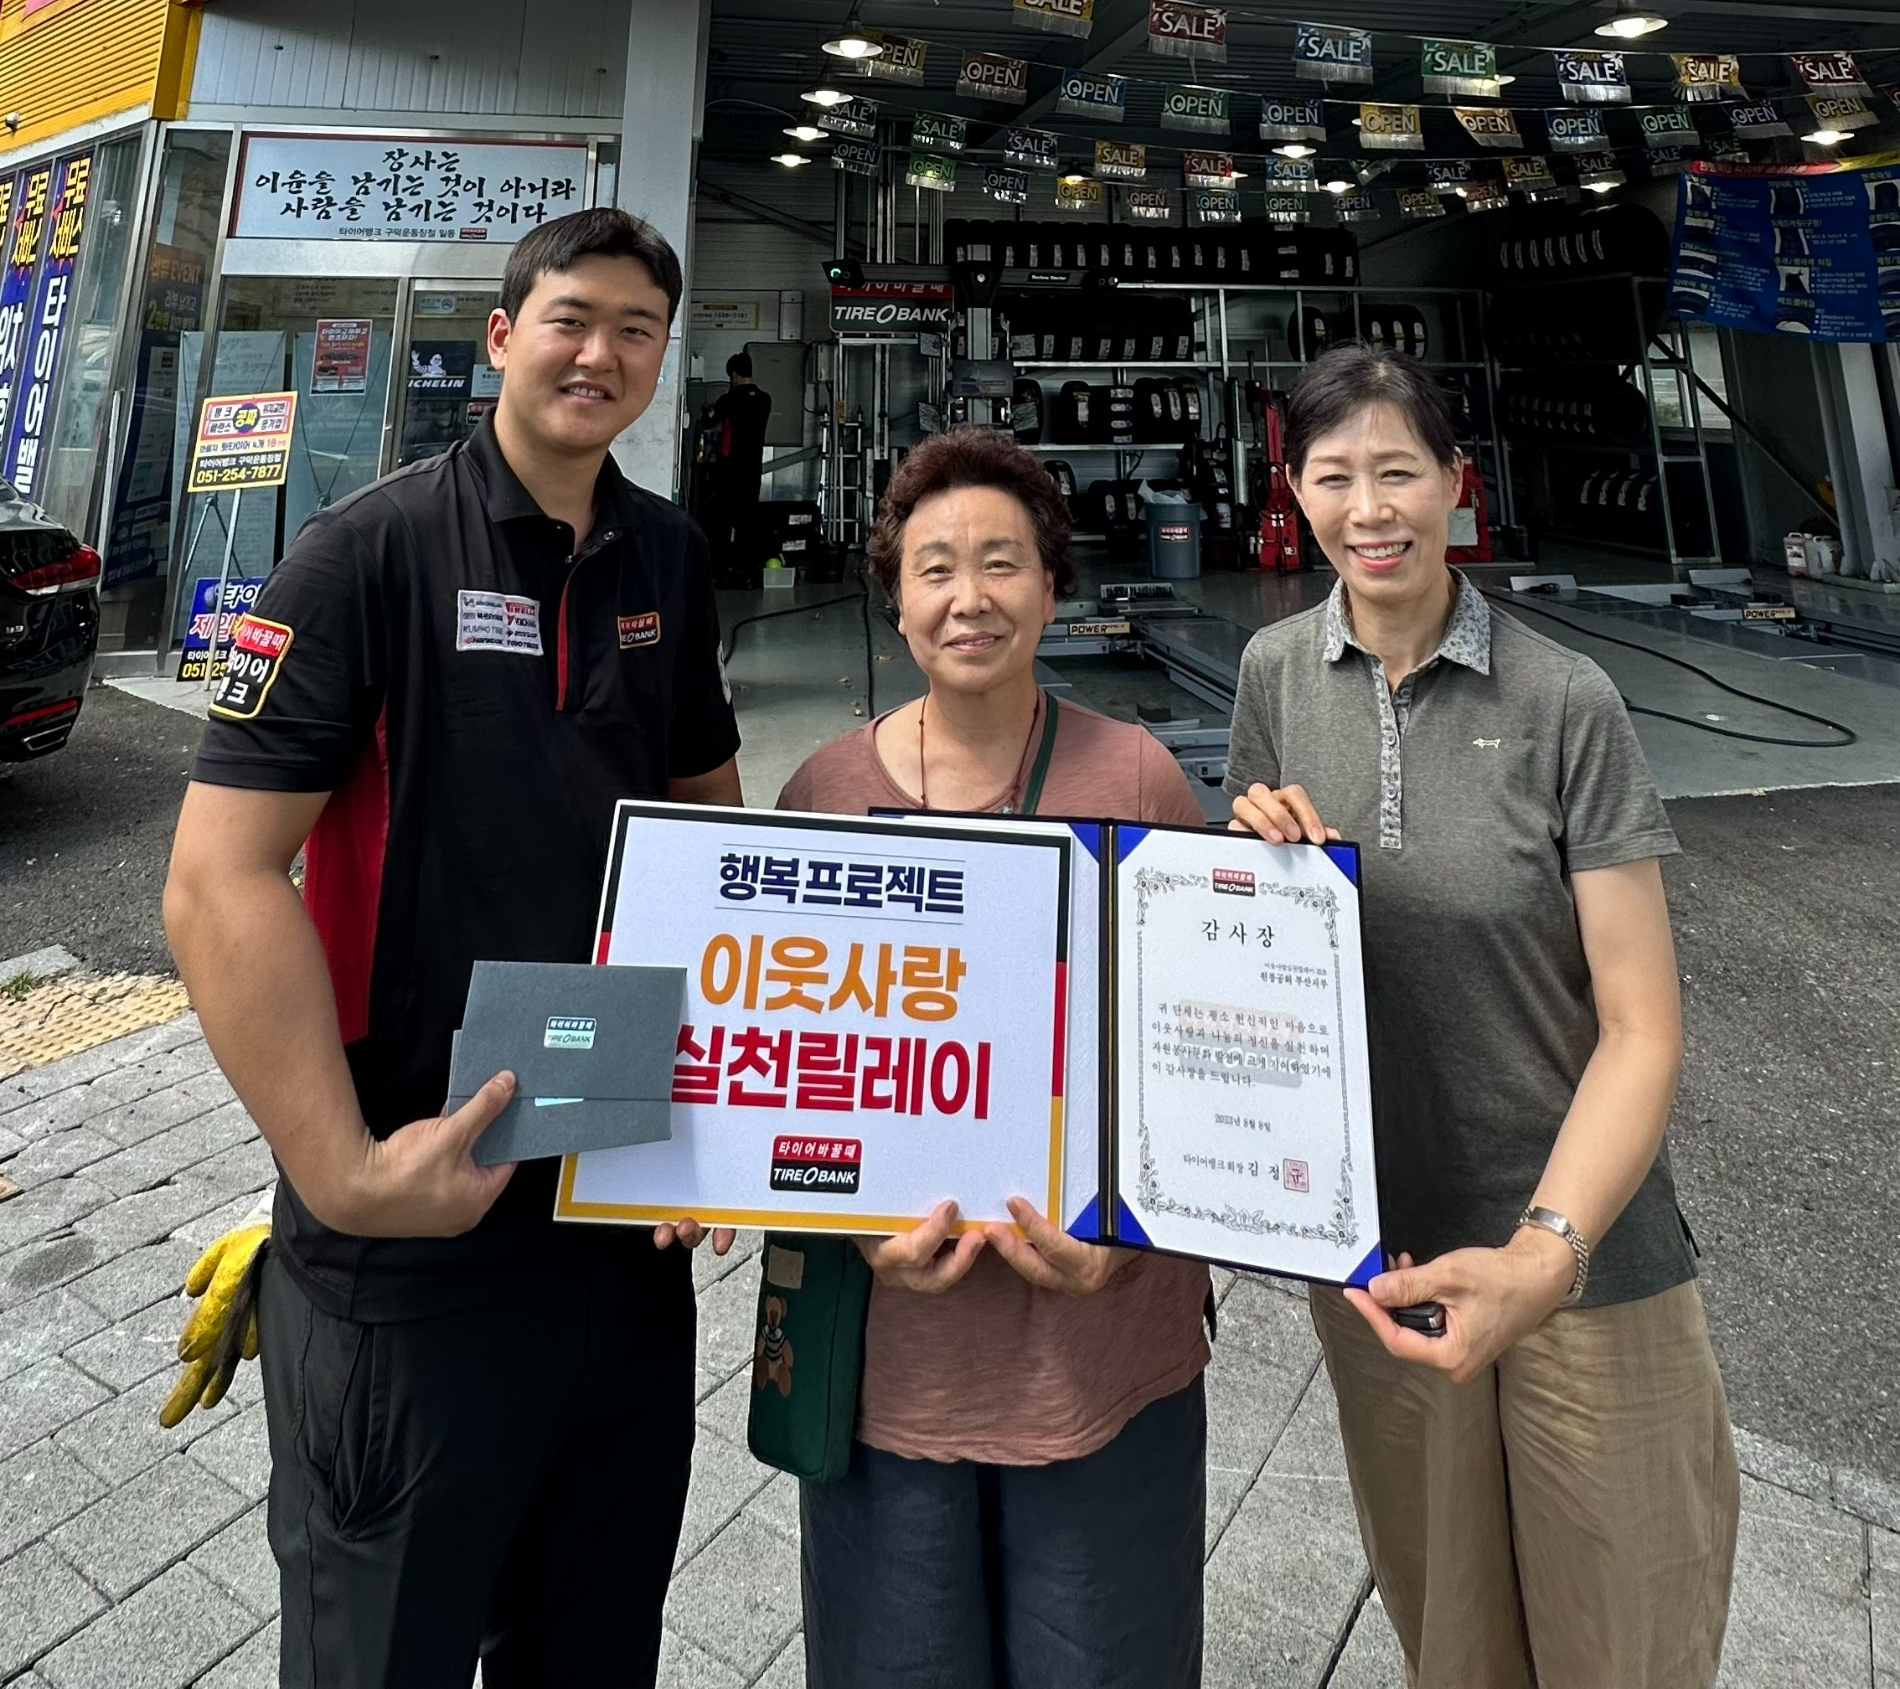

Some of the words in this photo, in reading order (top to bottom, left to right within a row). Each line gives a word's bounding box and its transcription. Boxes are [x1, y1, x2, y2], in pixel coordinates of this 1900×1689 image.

[1160, 12, 1217, 39] SALE
[880, 42, 920, 68] PEN
[1306, 37, 1361, 62] SALE
[1432, 51, 1487, 75] SALE
[1566, 61, 1617, 82] SALE
[1686, 59, 1731, 82] SALE
[1804, 61, 1854, 81] SALE
[964, 61, 1020, 87] OPEN
[1066, 79, 1120, 104] OPEN
[831, 101, 869, 122] SALE
[1170, 94, 1223, 117] OPEN
[1267, 104, 1319, 124] OPEN
[1816, 98, 1861, 117] OPEN
[1364, 113, 1415, 133] OPEN
[1461, 115, 1512, 133] OPEN
[1643, 113, 1689, 133] OPEN
[1733, 107, 1779, 125] OPEN
[920, 119, 958, 140] SALE
[1551, 117, 1601, 136] OPEN
[837, 144, 876, 163] OPEN
[1012, 135, 1050, 156] SALE
[1650, 147, 1682, 162] SALE
[1713, 138, 1741, 154] SALE
[382, 148, 460, 172] 장사는
[1101, 147, 1138, 167] SALE
[1191, 157, 1227, 175] SALE
[1580, 156, 1613, 172] SALE
[912, 159, 951, 179] OPEN
[1273, 161, 1307, 180] SALE
[1432, 165, 1470, 182] SALE
[1510, 161, 1544, 177] SALE
[65, 157, 91, 208] 무료
[256, 170, 335, 195] 이윤을
[351, 172, 424, 196] 남기는
[437, 175, 485, 198] 것이
[500, 177, 577, 200] 아니라
[987, 173, 1025, 191] OPEN
[1060, 183, 1098, 201] OPEN
[25, 170, 50, 219] 무료
[1129, 192, 1166, 207] OPEN
[1200, 195, 1235, 210] OPEN
[1268, 197, 1303, 211] OPEN
[1336, 196, 1371, 210] OPEN
[1401, 192, 1436, 206] OPEN
[281, 196, 365, 221] 사람을
[382, 198, 457, 222] 남기는
[470, 200, 548, 224] 것이다
[10, 217, 43, 266] 서비스
[48, 206, 84, 259] 서비스
[407, 379, 464, 388] ICHELIN
[197, 464, 281, 483] 051-254-7877
[1745, 610, 1776, 618] POWER
[1071, 625, 1107, 634] POWER
[719, 853, 965, 913] 행복프로젝트
[700, 933, 967, 1021] 이웃사랑
[1158, 1001, 1168, 1014] 귀
[1208, 1009, 1230, 1022] 평소
[1235, 1012, 1279, 1030] 헌신적인
[1285, 1019, 1330, 1036] 마음으로
[1152, 1020, 1205, 1040] 이웃사랑과
[1211, 1029, 1243, 1045] 나눔의
[1248, 1035, 1279, 1050] 정신을
[1285, 1040, 1330, 1058] 실천하며
[1247, 1054, 1266, 1068] 크게
[672, 1024, 992, 1120] 실천릴레이
[1152, 1061, 1161, 1074] 이
[1165, 1063, 1206, 1081] 감사장을
[1210, 1071, 1256, 1088] 드립니다.
[1248, 1160, 1259, 1177] 김
